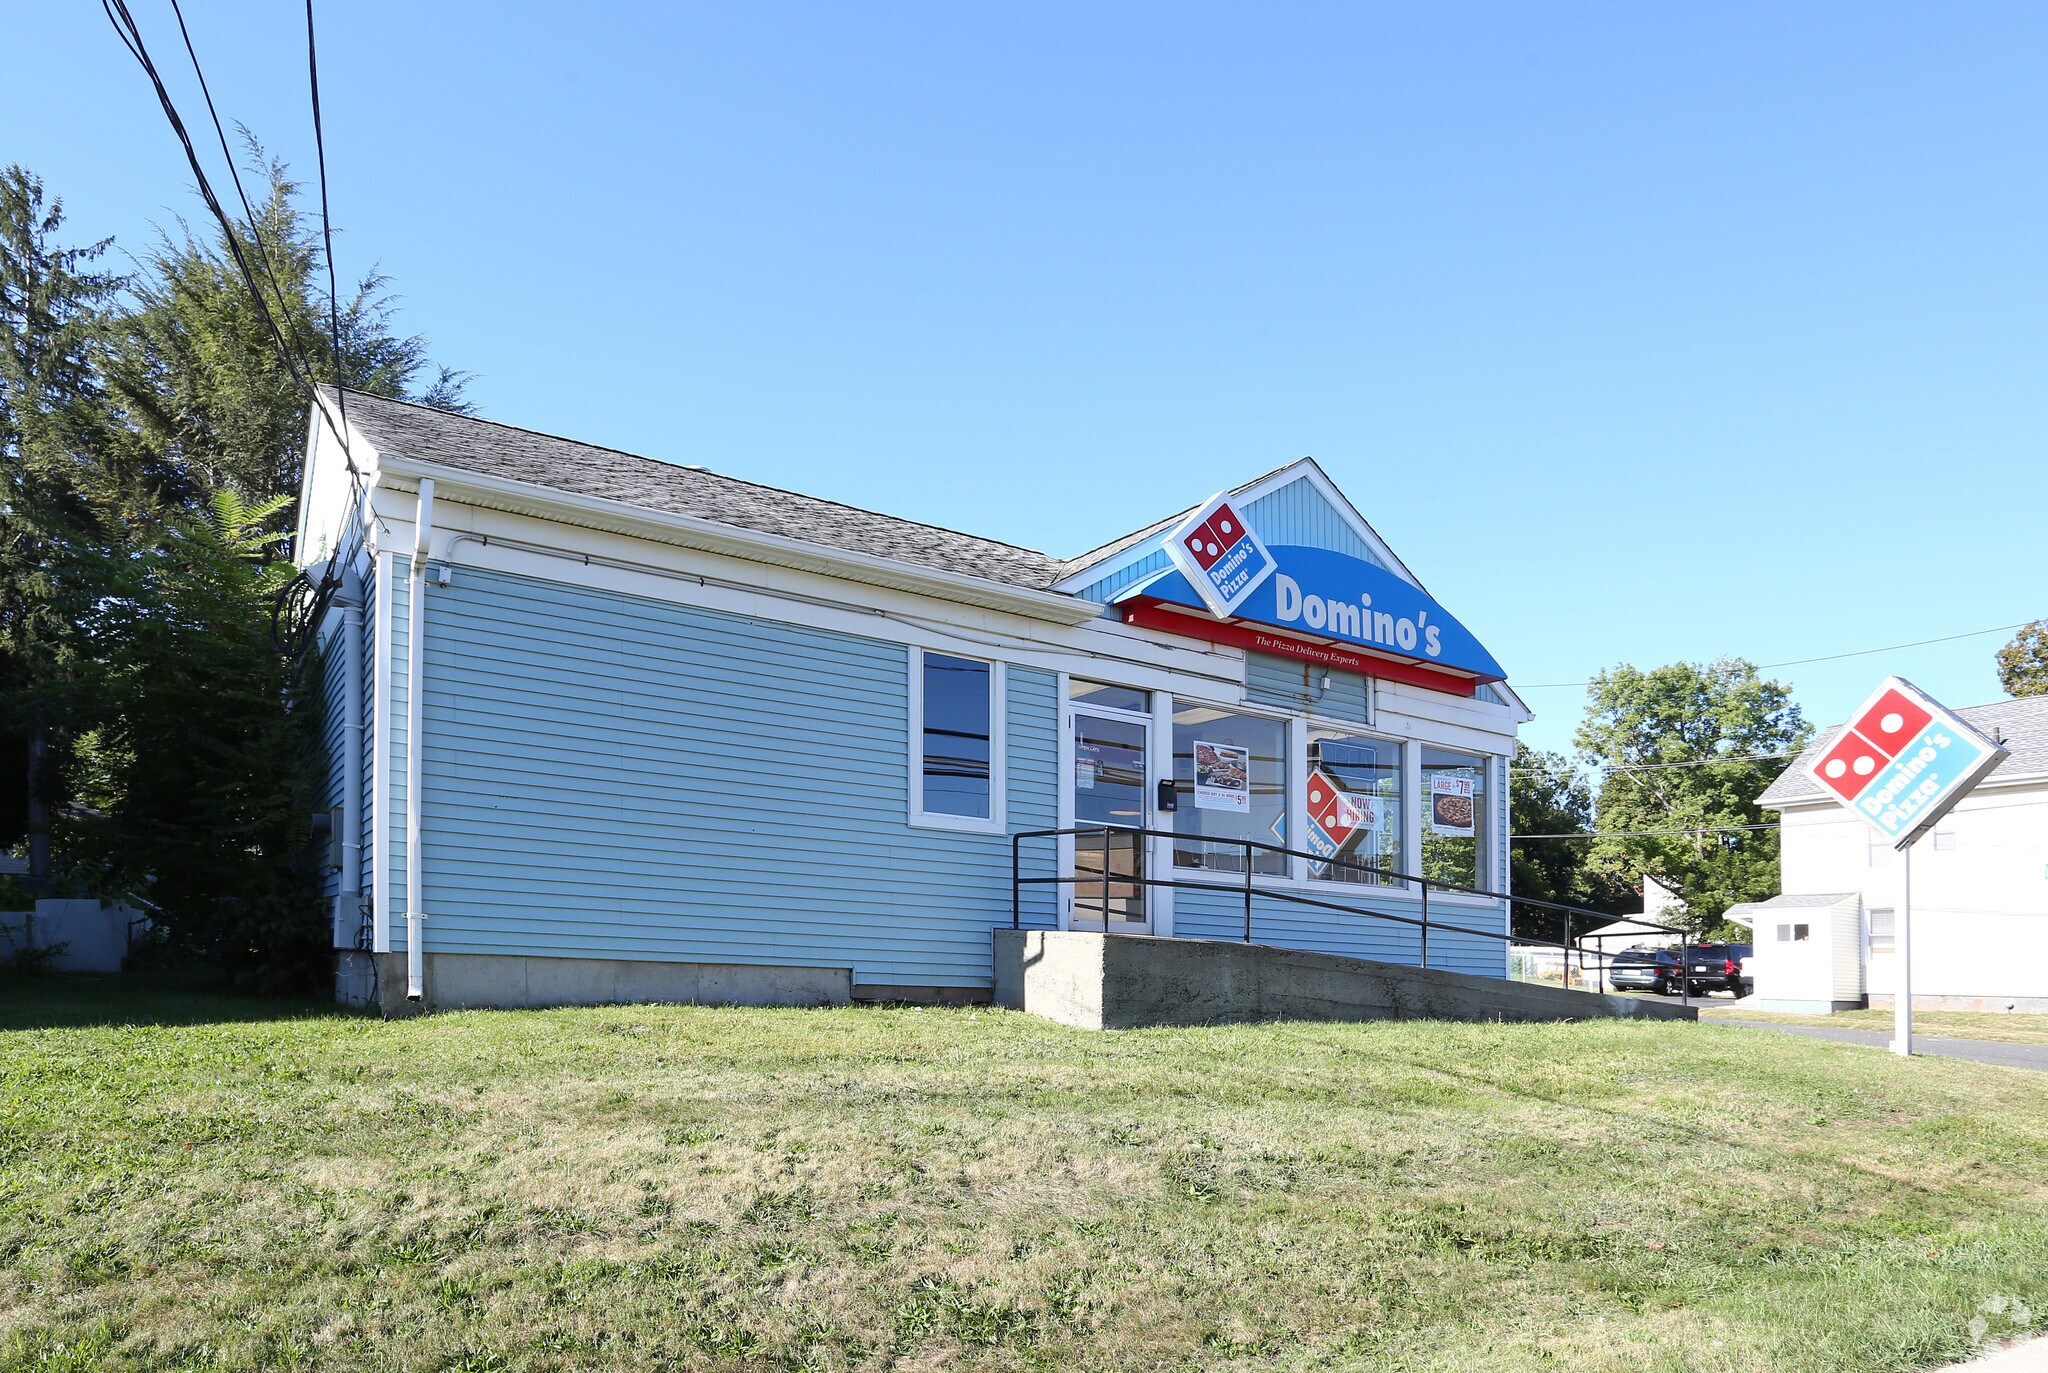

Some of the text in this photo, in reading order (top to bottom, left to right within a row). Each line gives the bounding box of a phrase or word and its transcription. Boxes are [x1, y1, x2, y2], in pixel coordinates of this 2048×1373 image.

[1210, 542, 1254, 586] Domino's
[1219, 572, 1249, 599] Pizza
[1275, 572, 1442, 657] Domino's
[1256, 635, 1360, 666] The Pizza Delivery Experts
[1433, 780, 1451, 791] LARGE
[1860, 732, 1952, 817] Domino's
[1347, 809, 1374, 824] HIRING
[1351, 796, 1370, 810] NOW
[1878, 777, 1941, 832] Pizza
